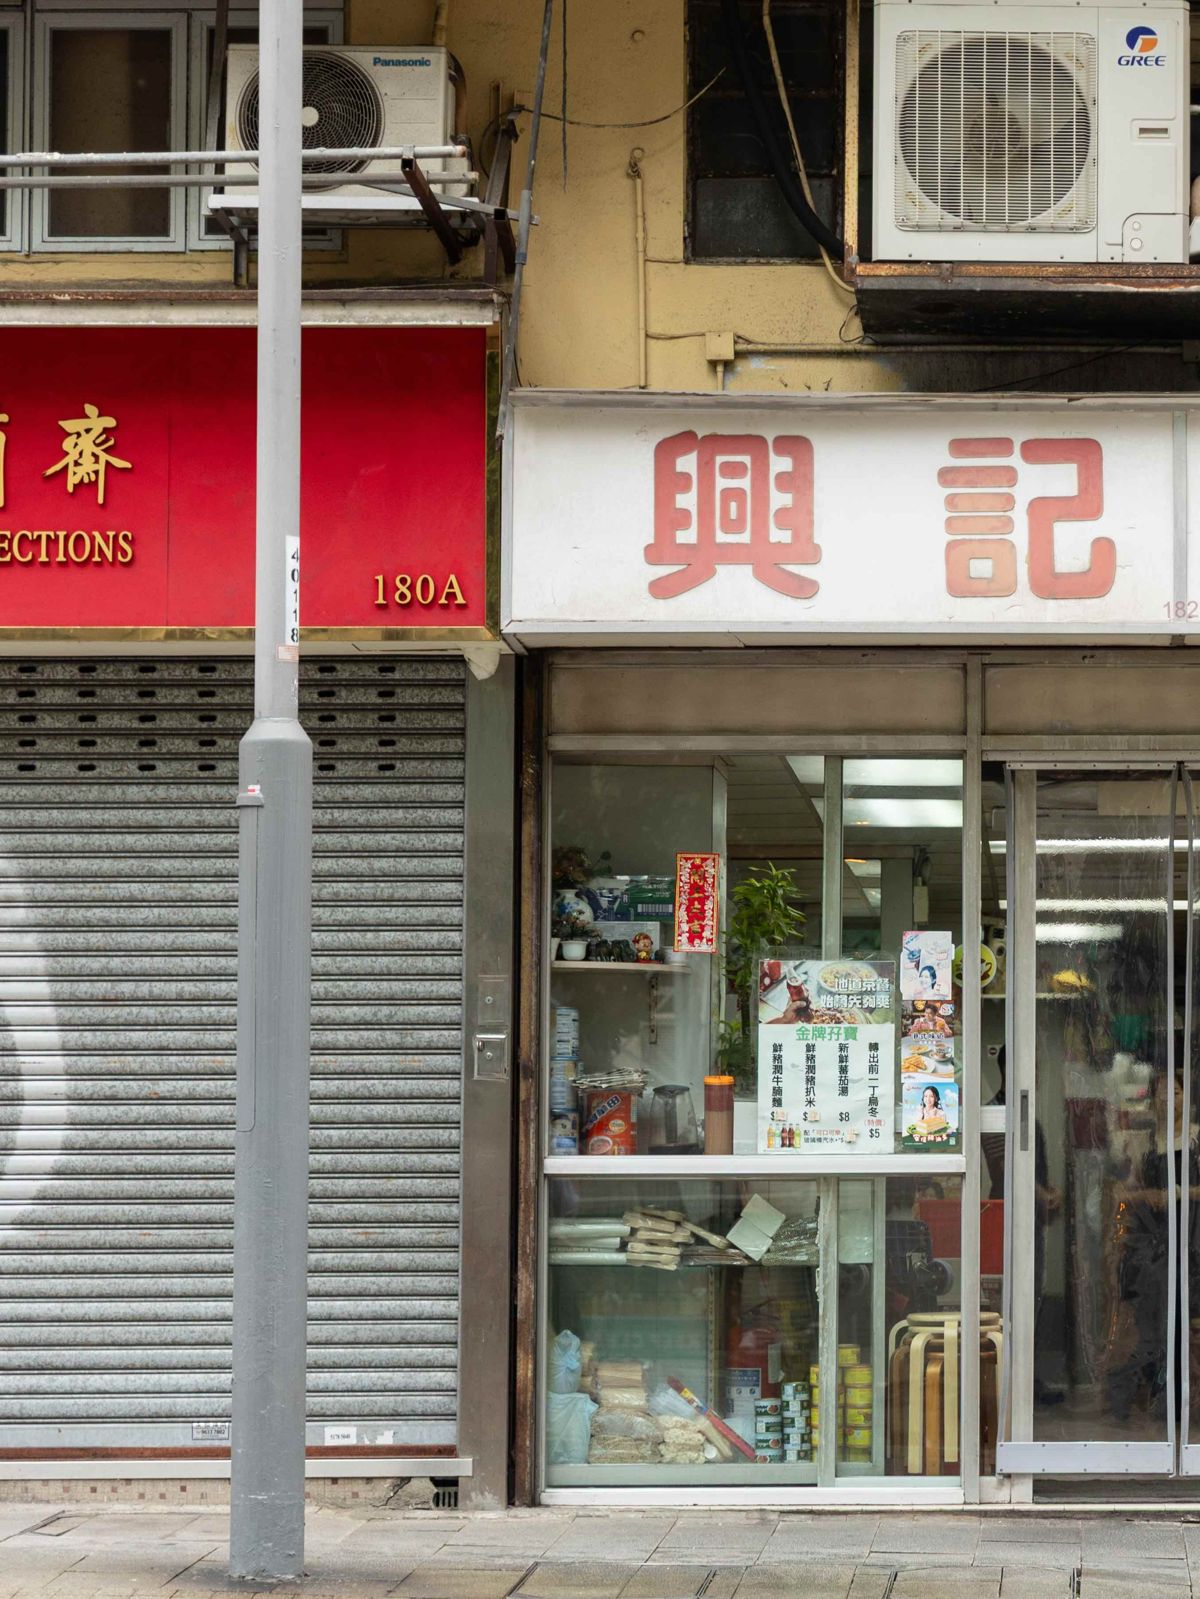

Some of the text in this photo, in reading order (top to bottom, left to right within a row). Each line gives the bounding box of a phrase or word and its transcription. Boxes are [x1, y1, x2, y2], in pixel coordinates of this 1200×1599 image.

[373, 56, 431, 67] Panasonic
[1117, 55, 1167, 67] GREE
[0, 531, 133, 562] ECTIONS
[374, 574, 467, 604] 180A
[1163, 600, 1199, 619] 182
[838, 1111, 850, 1122] $8
[868, 1128, 880, 1139] $5
